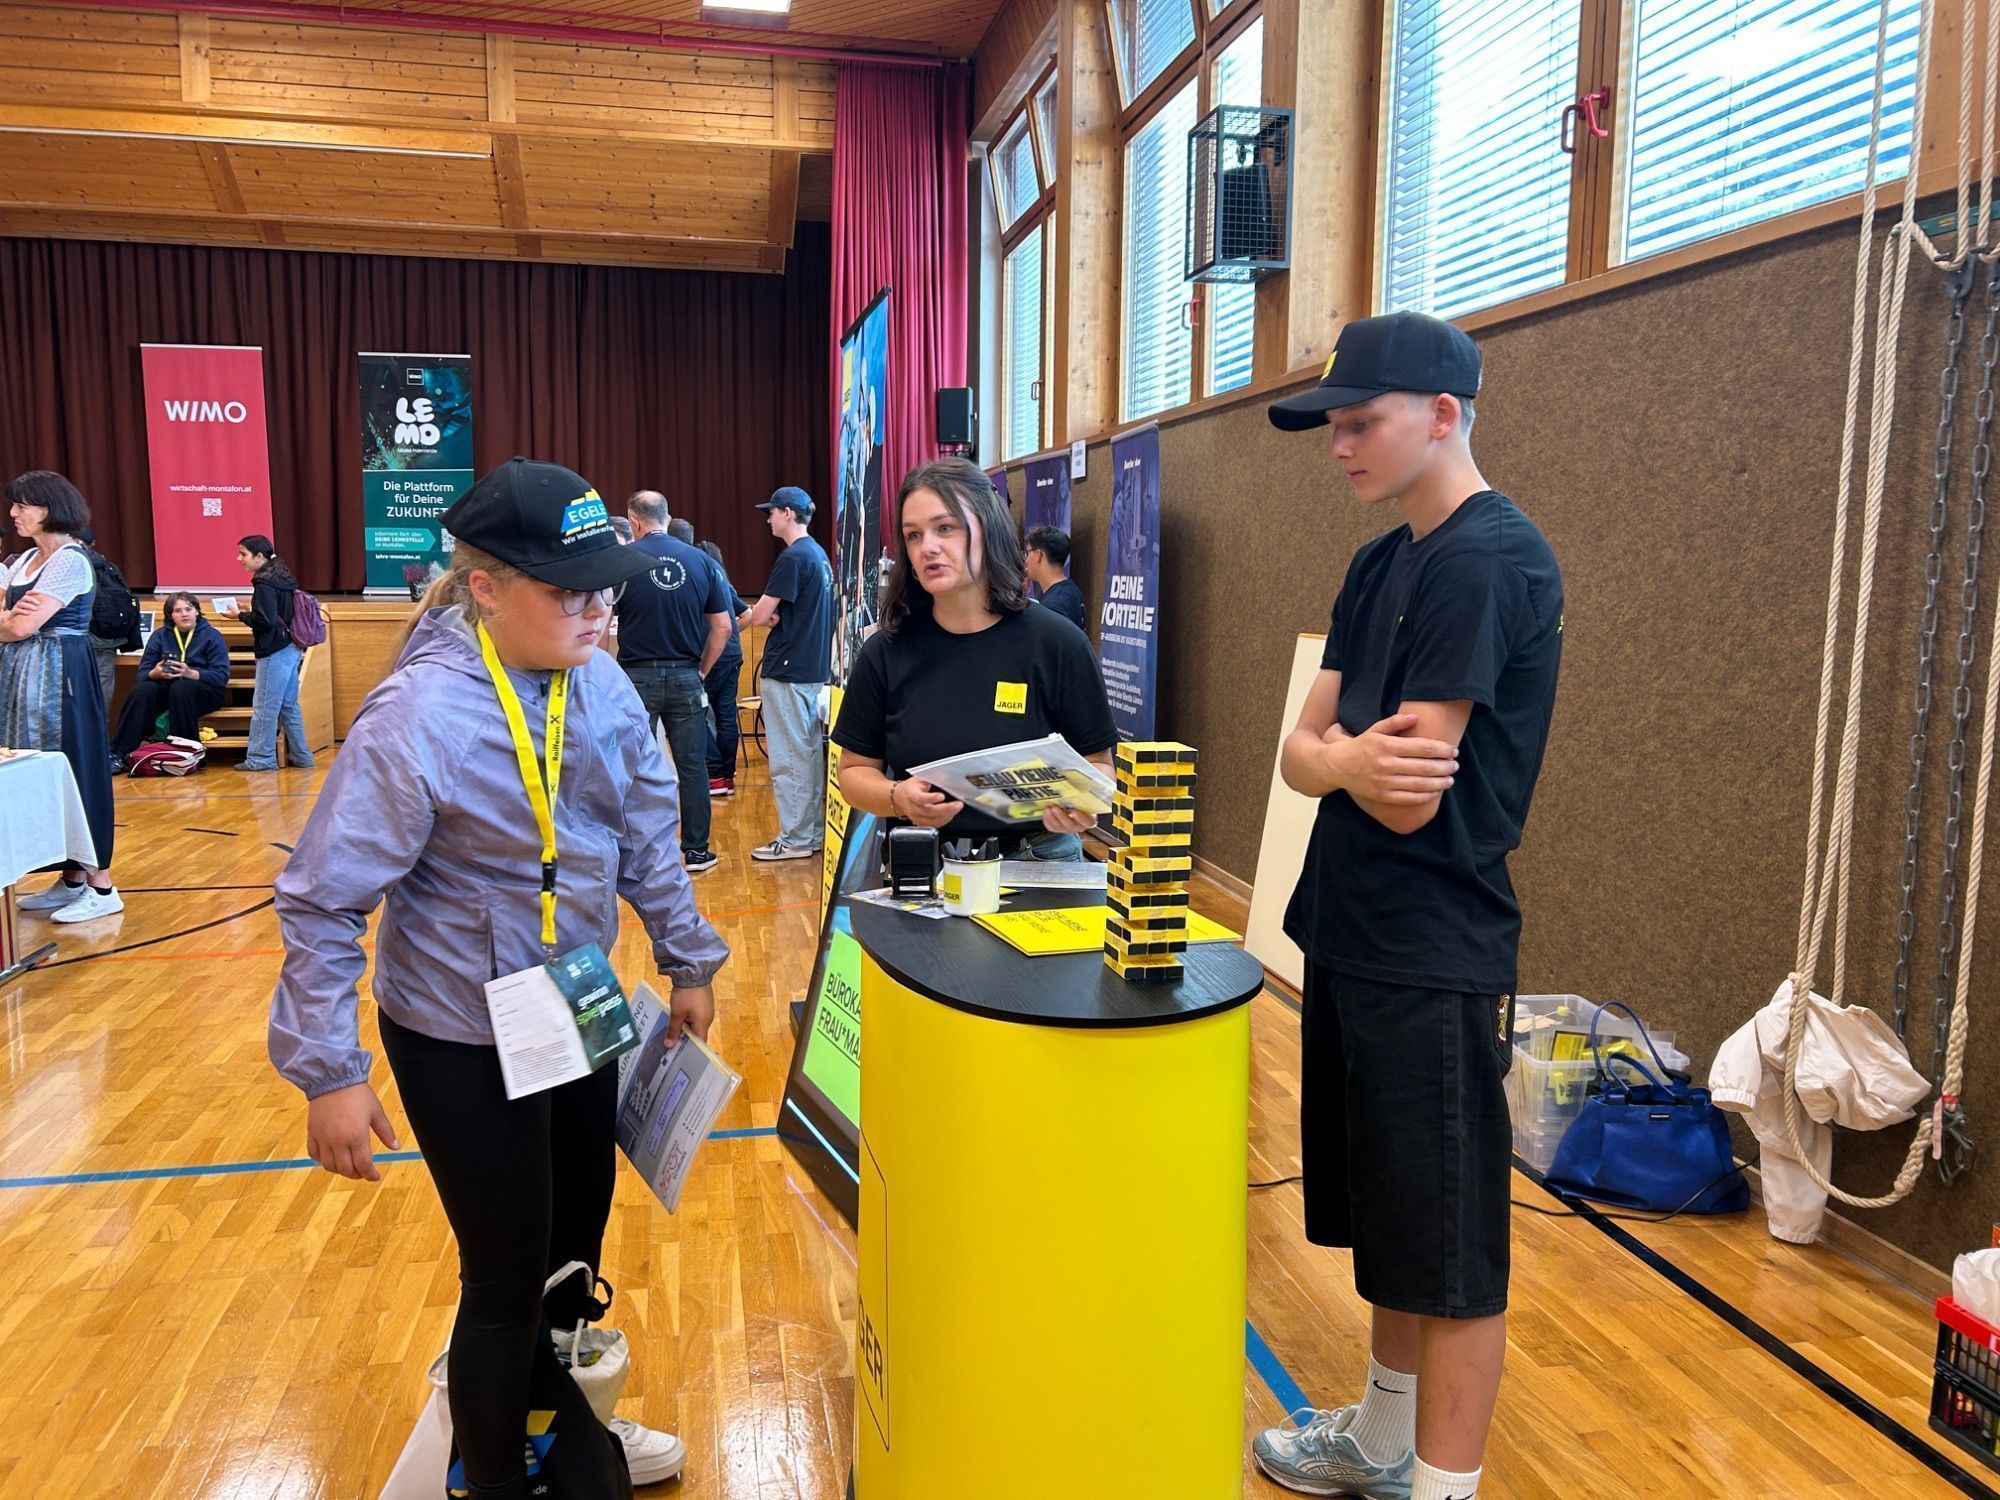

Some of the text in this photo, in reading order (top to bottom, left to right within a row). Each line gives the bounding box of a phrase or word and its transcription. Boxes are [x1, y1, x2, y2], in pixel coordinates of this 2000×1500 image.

[164, 400, 247, 423] WIMO
[396, 397, 435, 423] LE
[394, 423, 440, 446] MO
[169, 485, 252, 493] wirtschaft-montafon.at
[383, 481, 454, 492] Die Plattform
[394, 493, 444, 504] für Deine
[561, 536, 576, 546] Wir
[1110, 575, 1144, 601] DEINE
[552, 726, 561, 761] Raiffeisen
[1013, 766, 1066, 784] MEINE
[1001, 785, 1060, 801] PARTIE
